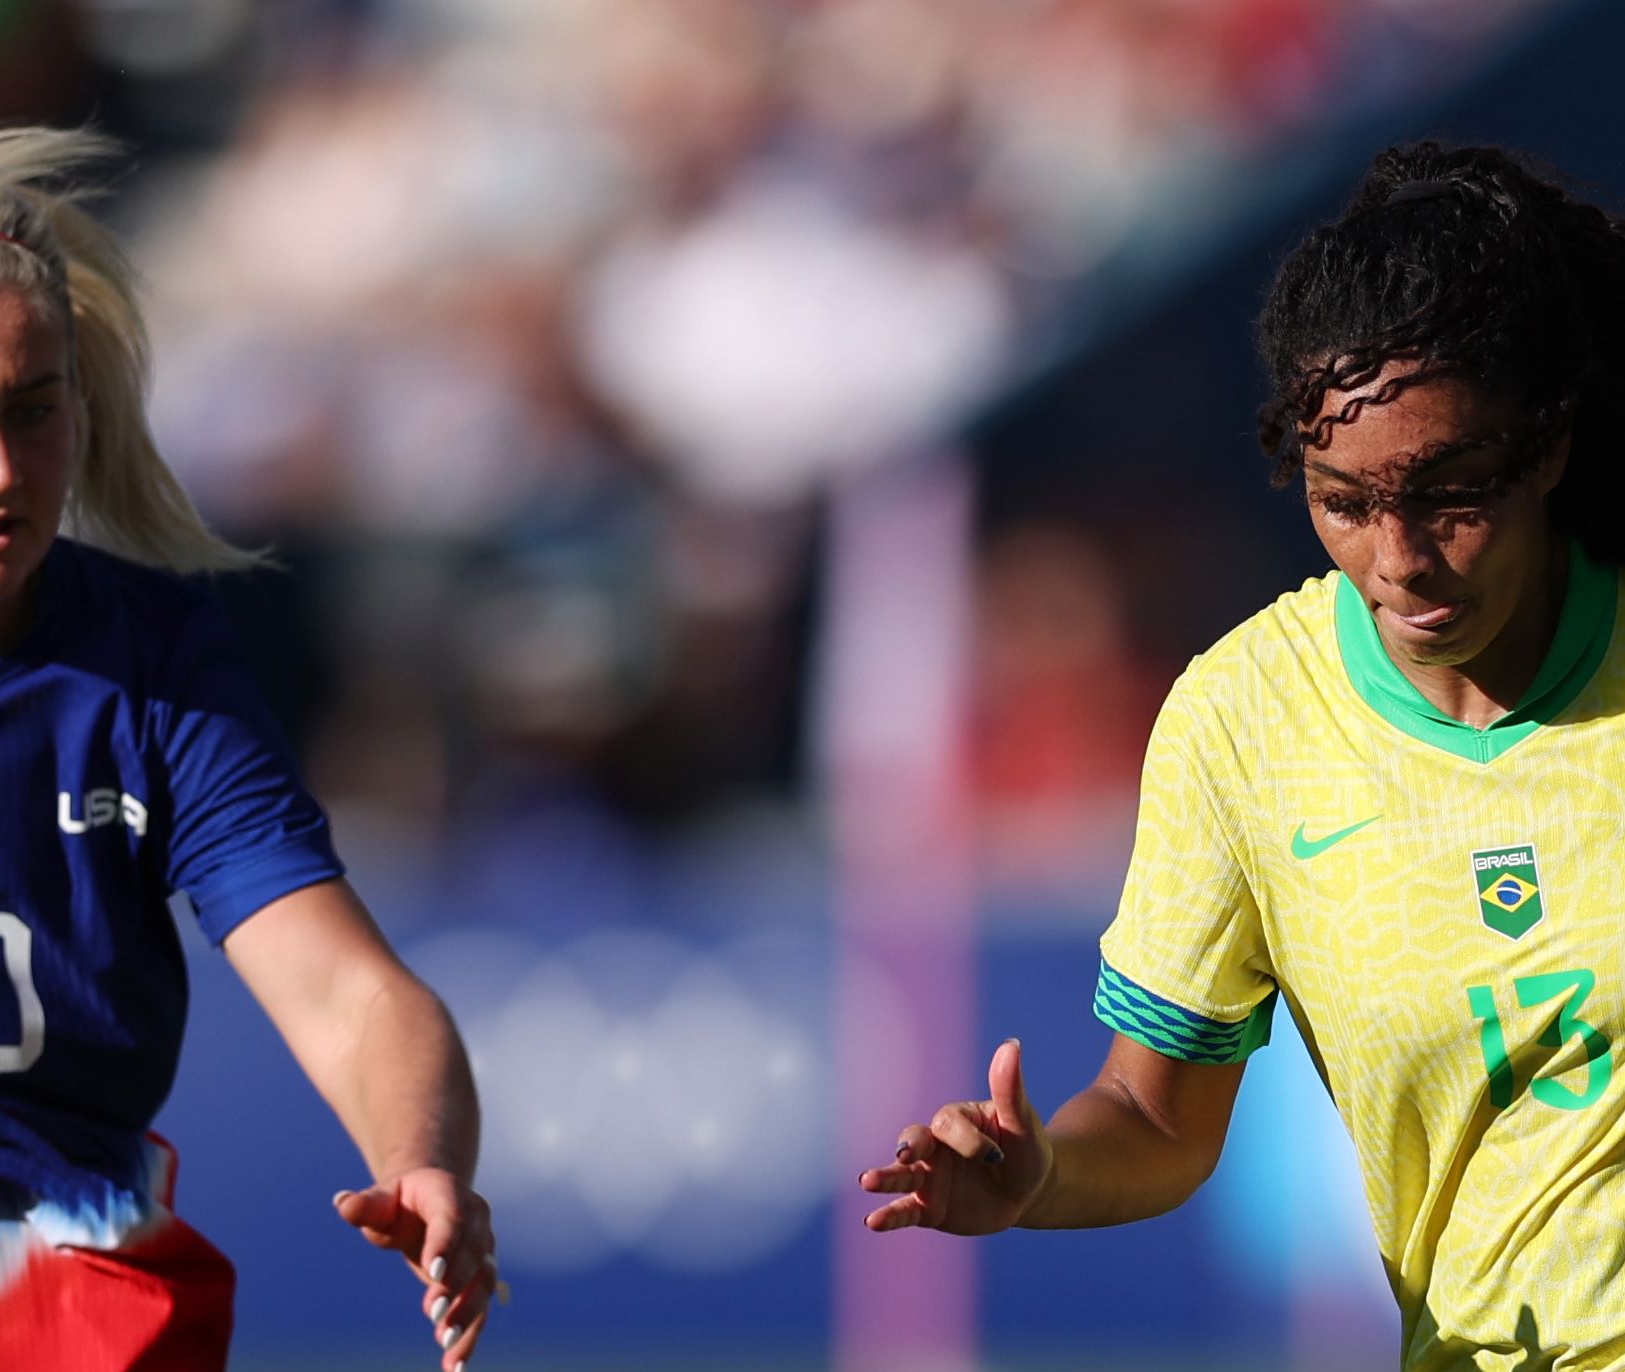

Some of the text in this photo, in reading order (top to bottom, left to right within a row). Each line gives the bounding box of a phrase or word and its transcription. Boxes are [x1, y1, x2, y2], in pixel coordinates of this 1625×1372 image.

[58, 788, 148, 836] USA
[1475, 851, 1534, 871] BRASIL
[1467, 968, 1613, 1111] 13
